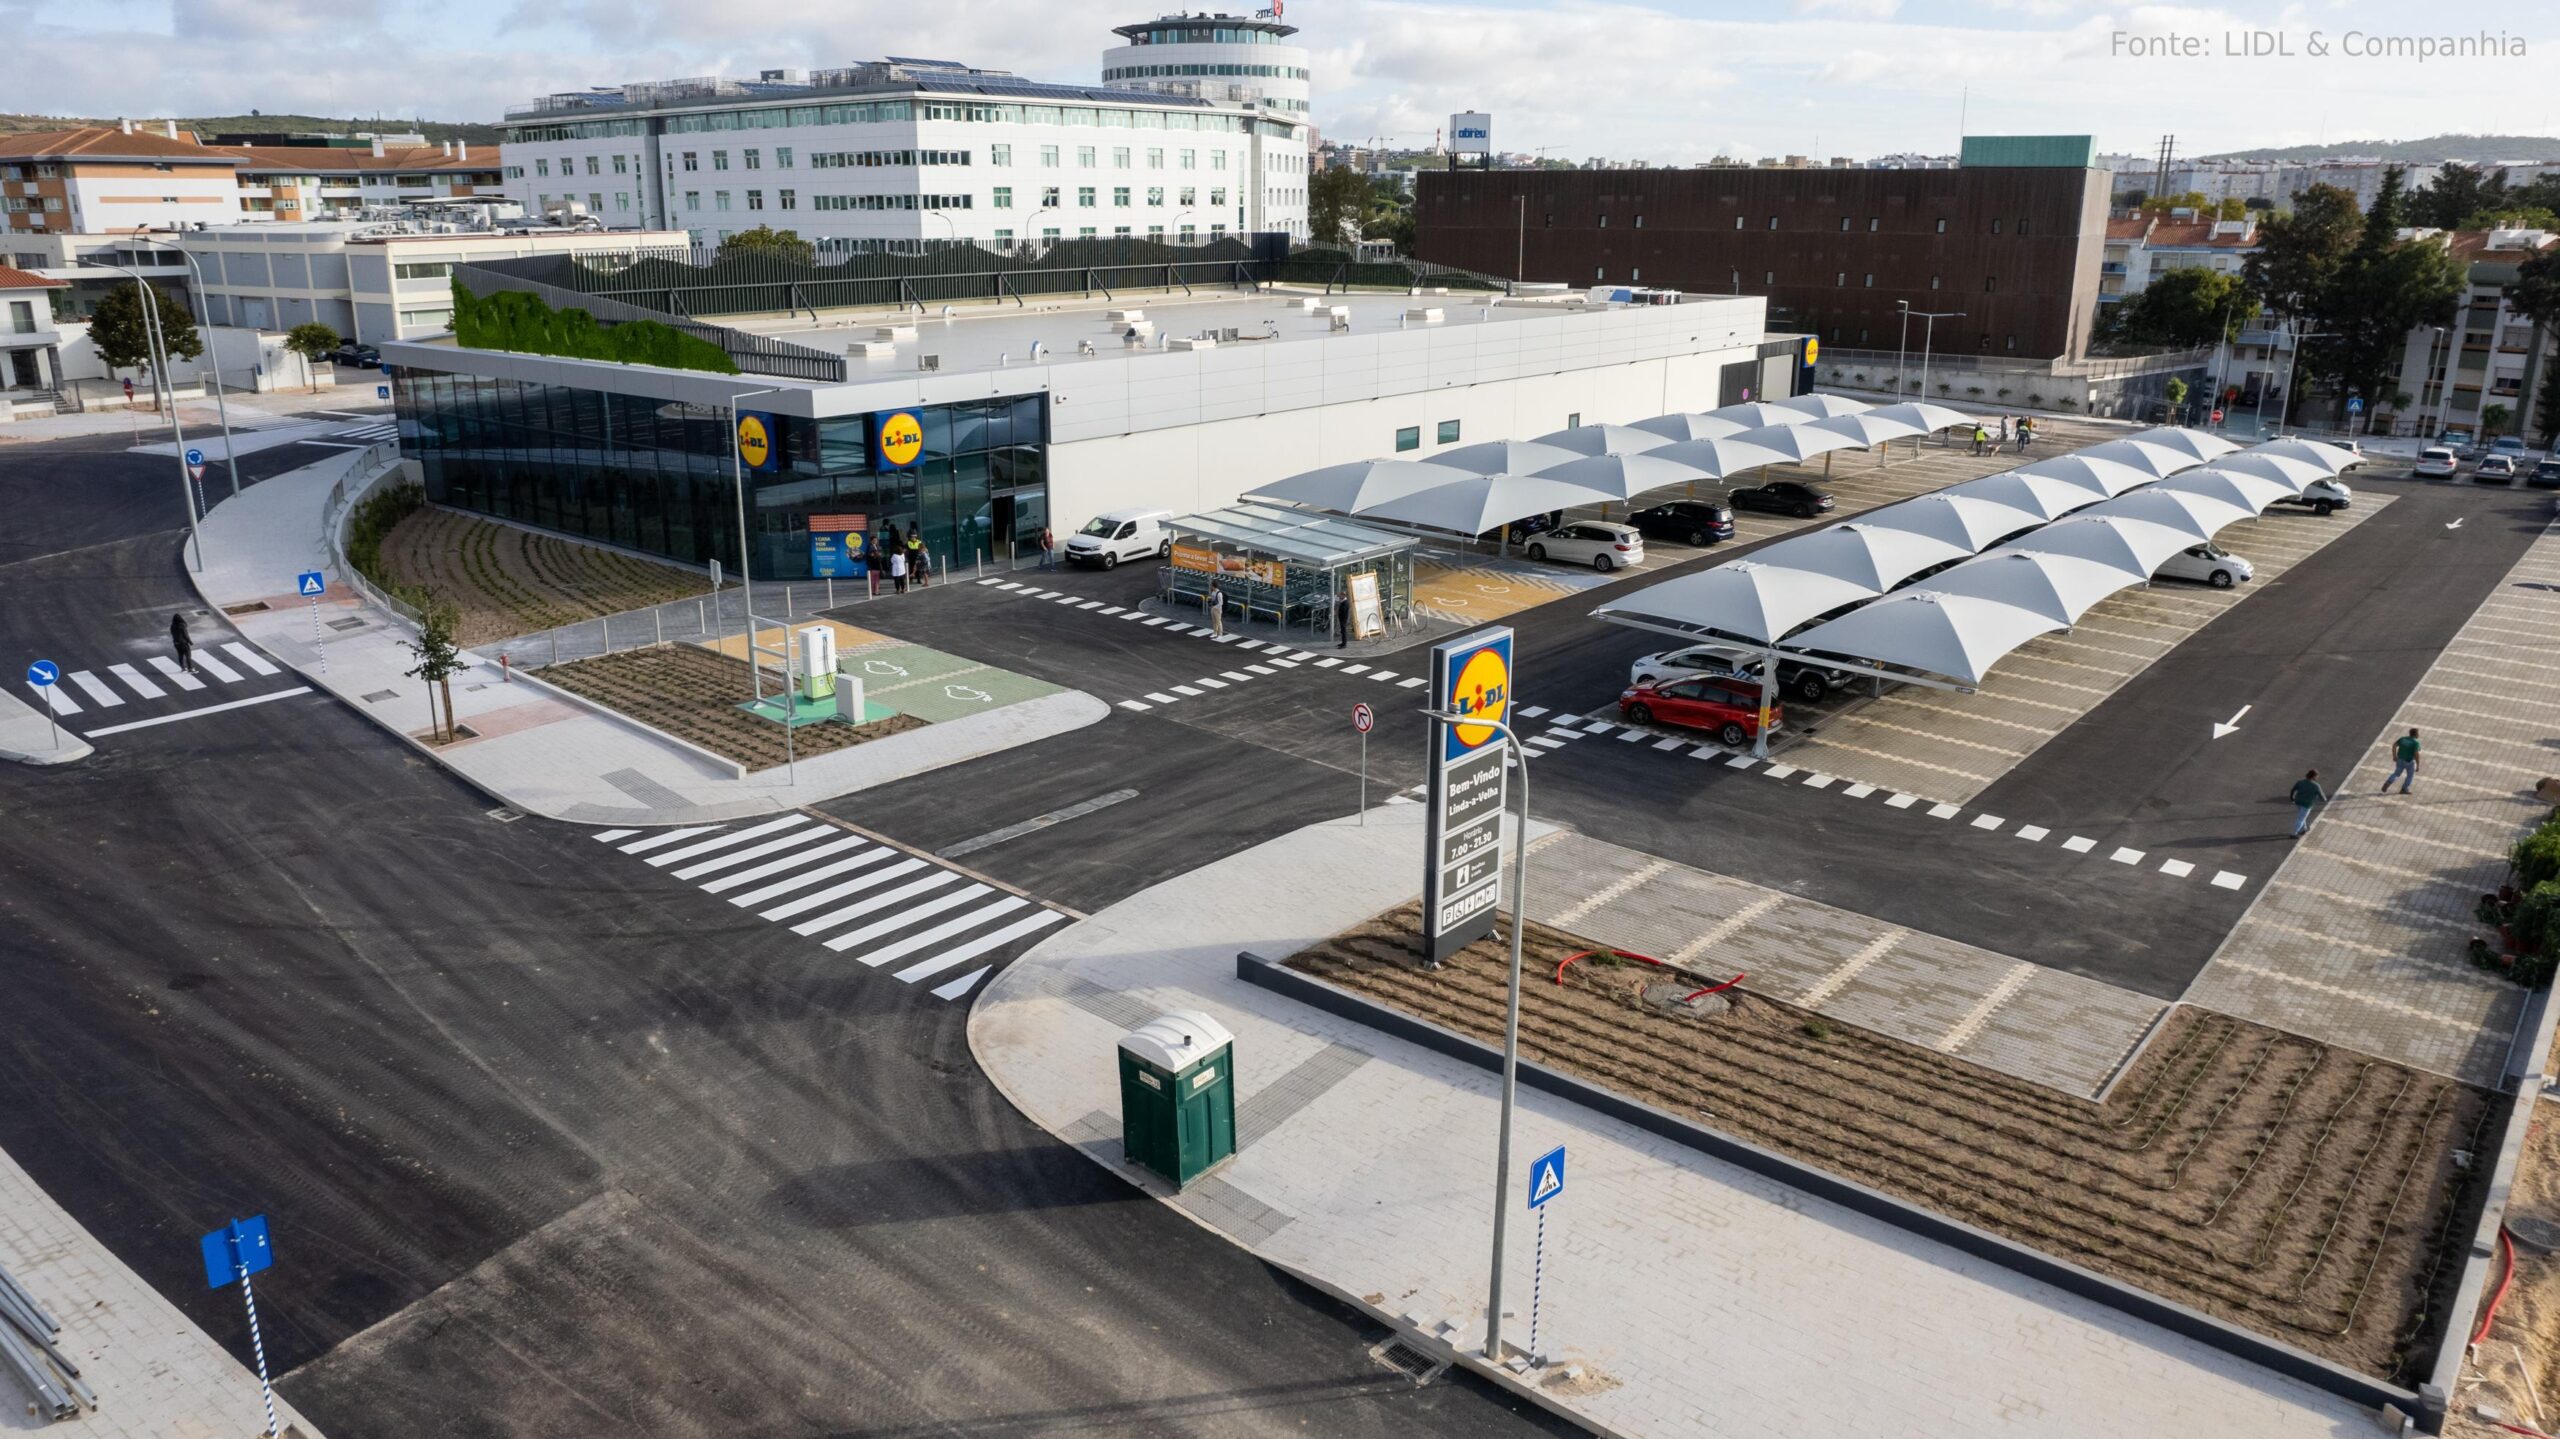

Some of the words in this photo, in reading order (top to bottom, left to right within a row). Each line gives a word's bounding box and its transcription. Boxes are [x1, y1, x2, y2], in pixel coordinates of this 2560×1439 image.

[1449, 765, 1500, 798] Bem-Vindo
[1449, 786, 1499, 816] Linda-a-Velha
[1451, 843, 1468, 860] 7.00
[1473, 831, 1492, 849] 21.30
